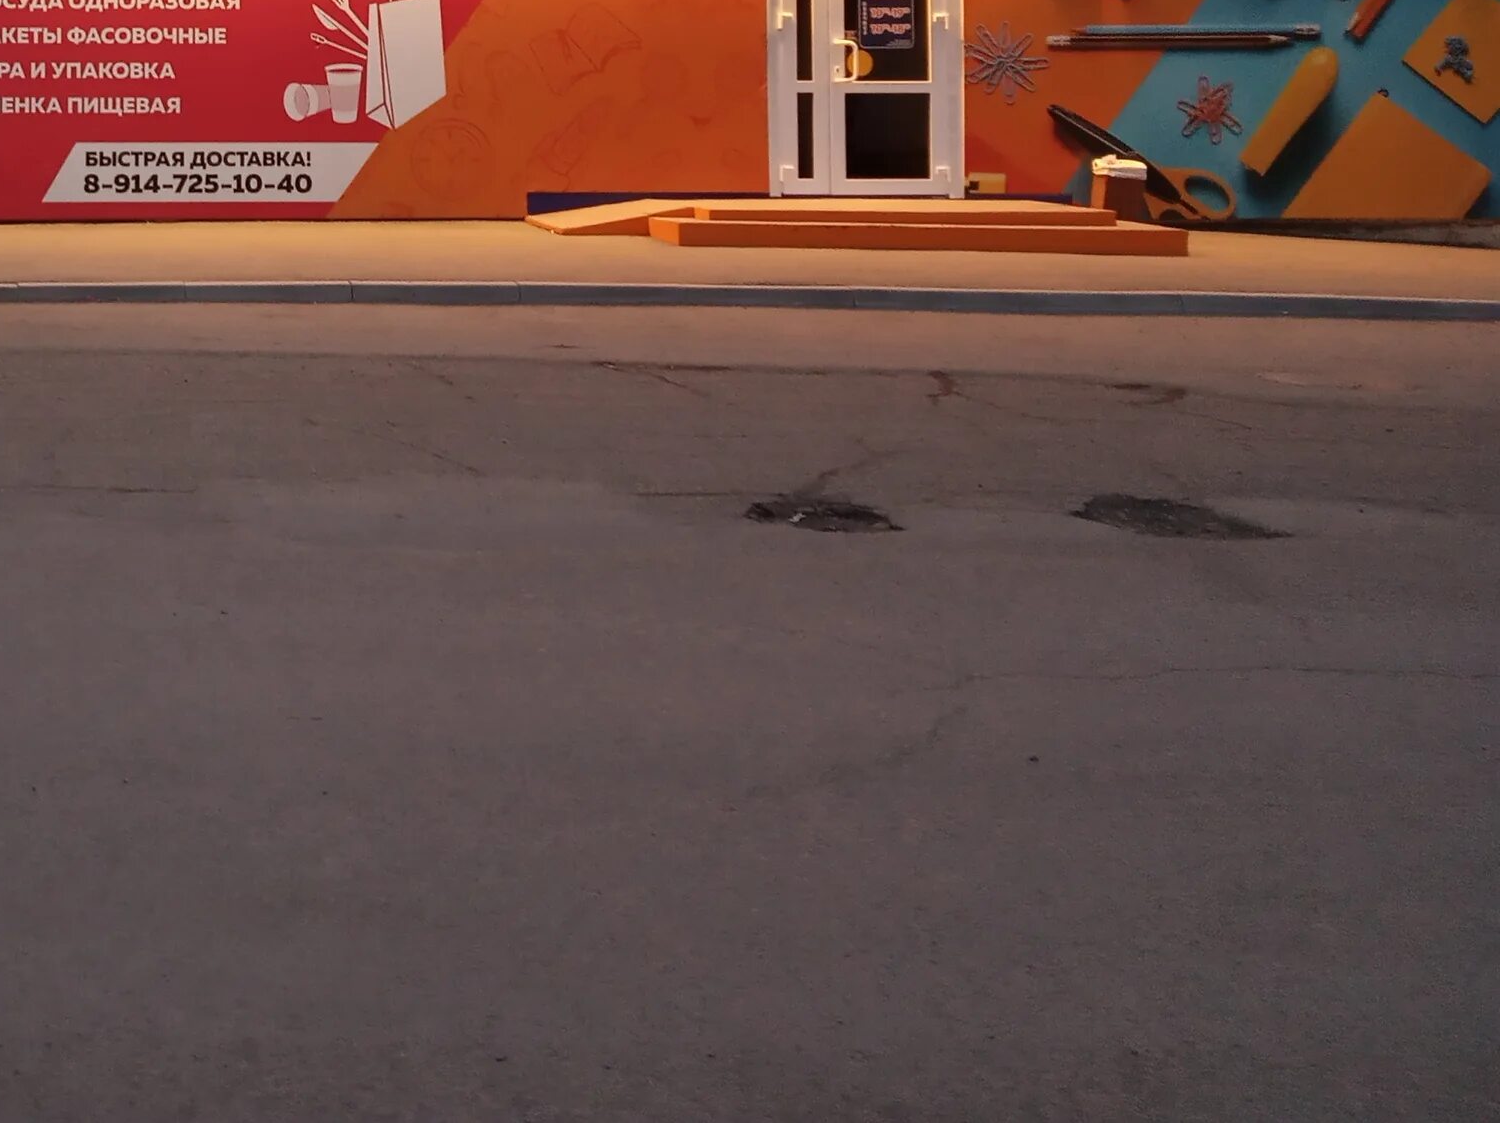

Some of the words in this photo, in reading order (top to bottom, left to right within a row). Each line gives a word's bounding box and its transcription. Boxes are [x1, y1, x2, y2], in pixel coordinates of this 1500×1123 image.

[66, 26, 227, 45] ФАСОВОЧНЫЕ
[30, 62, 46, 79] И
[51, 62, 176, 80] УПАКОВКА
[66, 96, 182, 117] ПИЩЕВАЯ
[84, 151, 185, 168] БЫСТРАЯ
[190, 151, 311, 172] ДОСТАВКА!
[83, 173, 313, 195] 8-914-725-10-40
